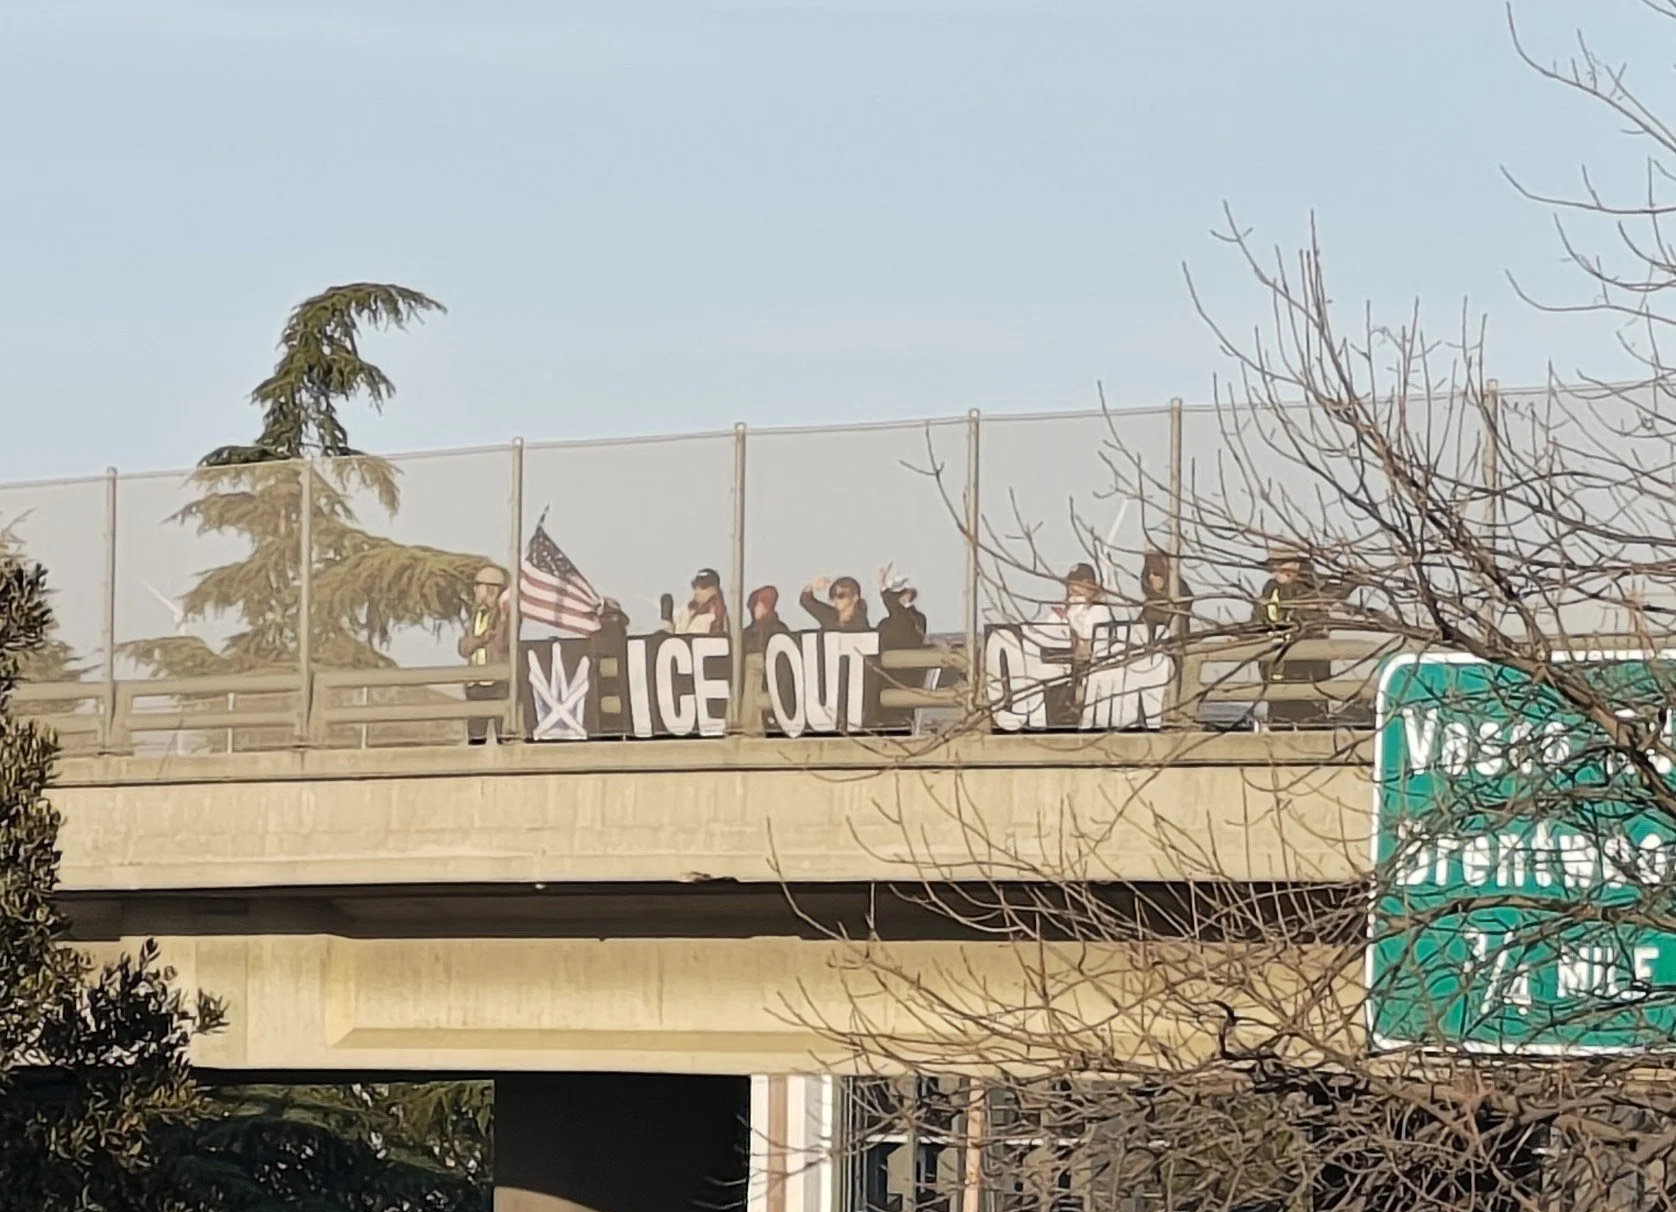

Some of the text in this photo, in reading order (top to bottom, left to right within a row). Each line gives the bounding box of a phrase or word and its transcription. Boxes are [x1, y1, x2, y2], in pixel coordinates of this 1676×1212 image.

[626, 637, 730, 738] ICE
[765, 631, 880, 739] OUT
[985, 623, 1073, 732] OF
[1403, 707, 1571, 776] Vasco
[1395, 819, 1676, 889] Brentwoo
[1556, 943, 1660, 1000] MILE
